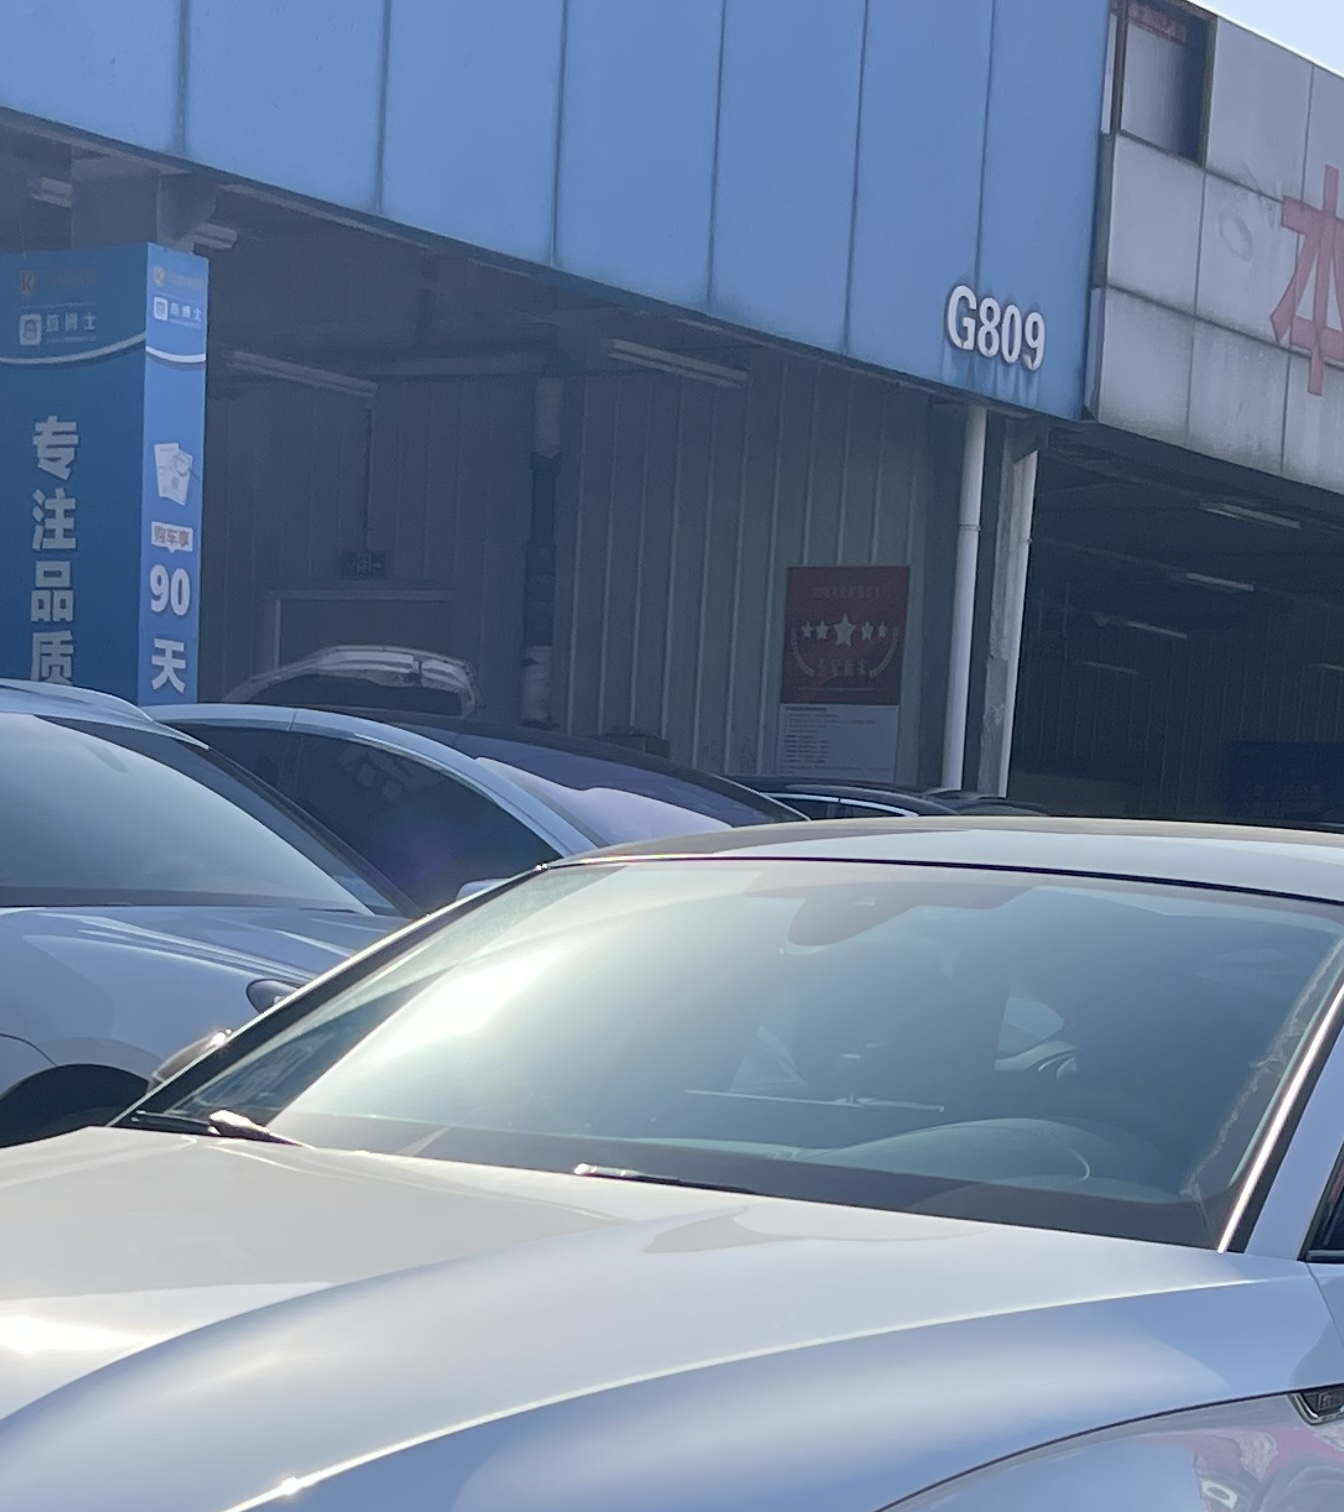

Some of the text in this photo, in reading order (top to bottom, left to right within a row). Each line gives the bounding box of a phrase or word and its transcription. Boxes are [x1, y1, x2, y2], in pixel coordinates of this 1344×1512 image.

[946, 285, 1046, 371] G809
[30, 415, 80, 686] 专注品质
